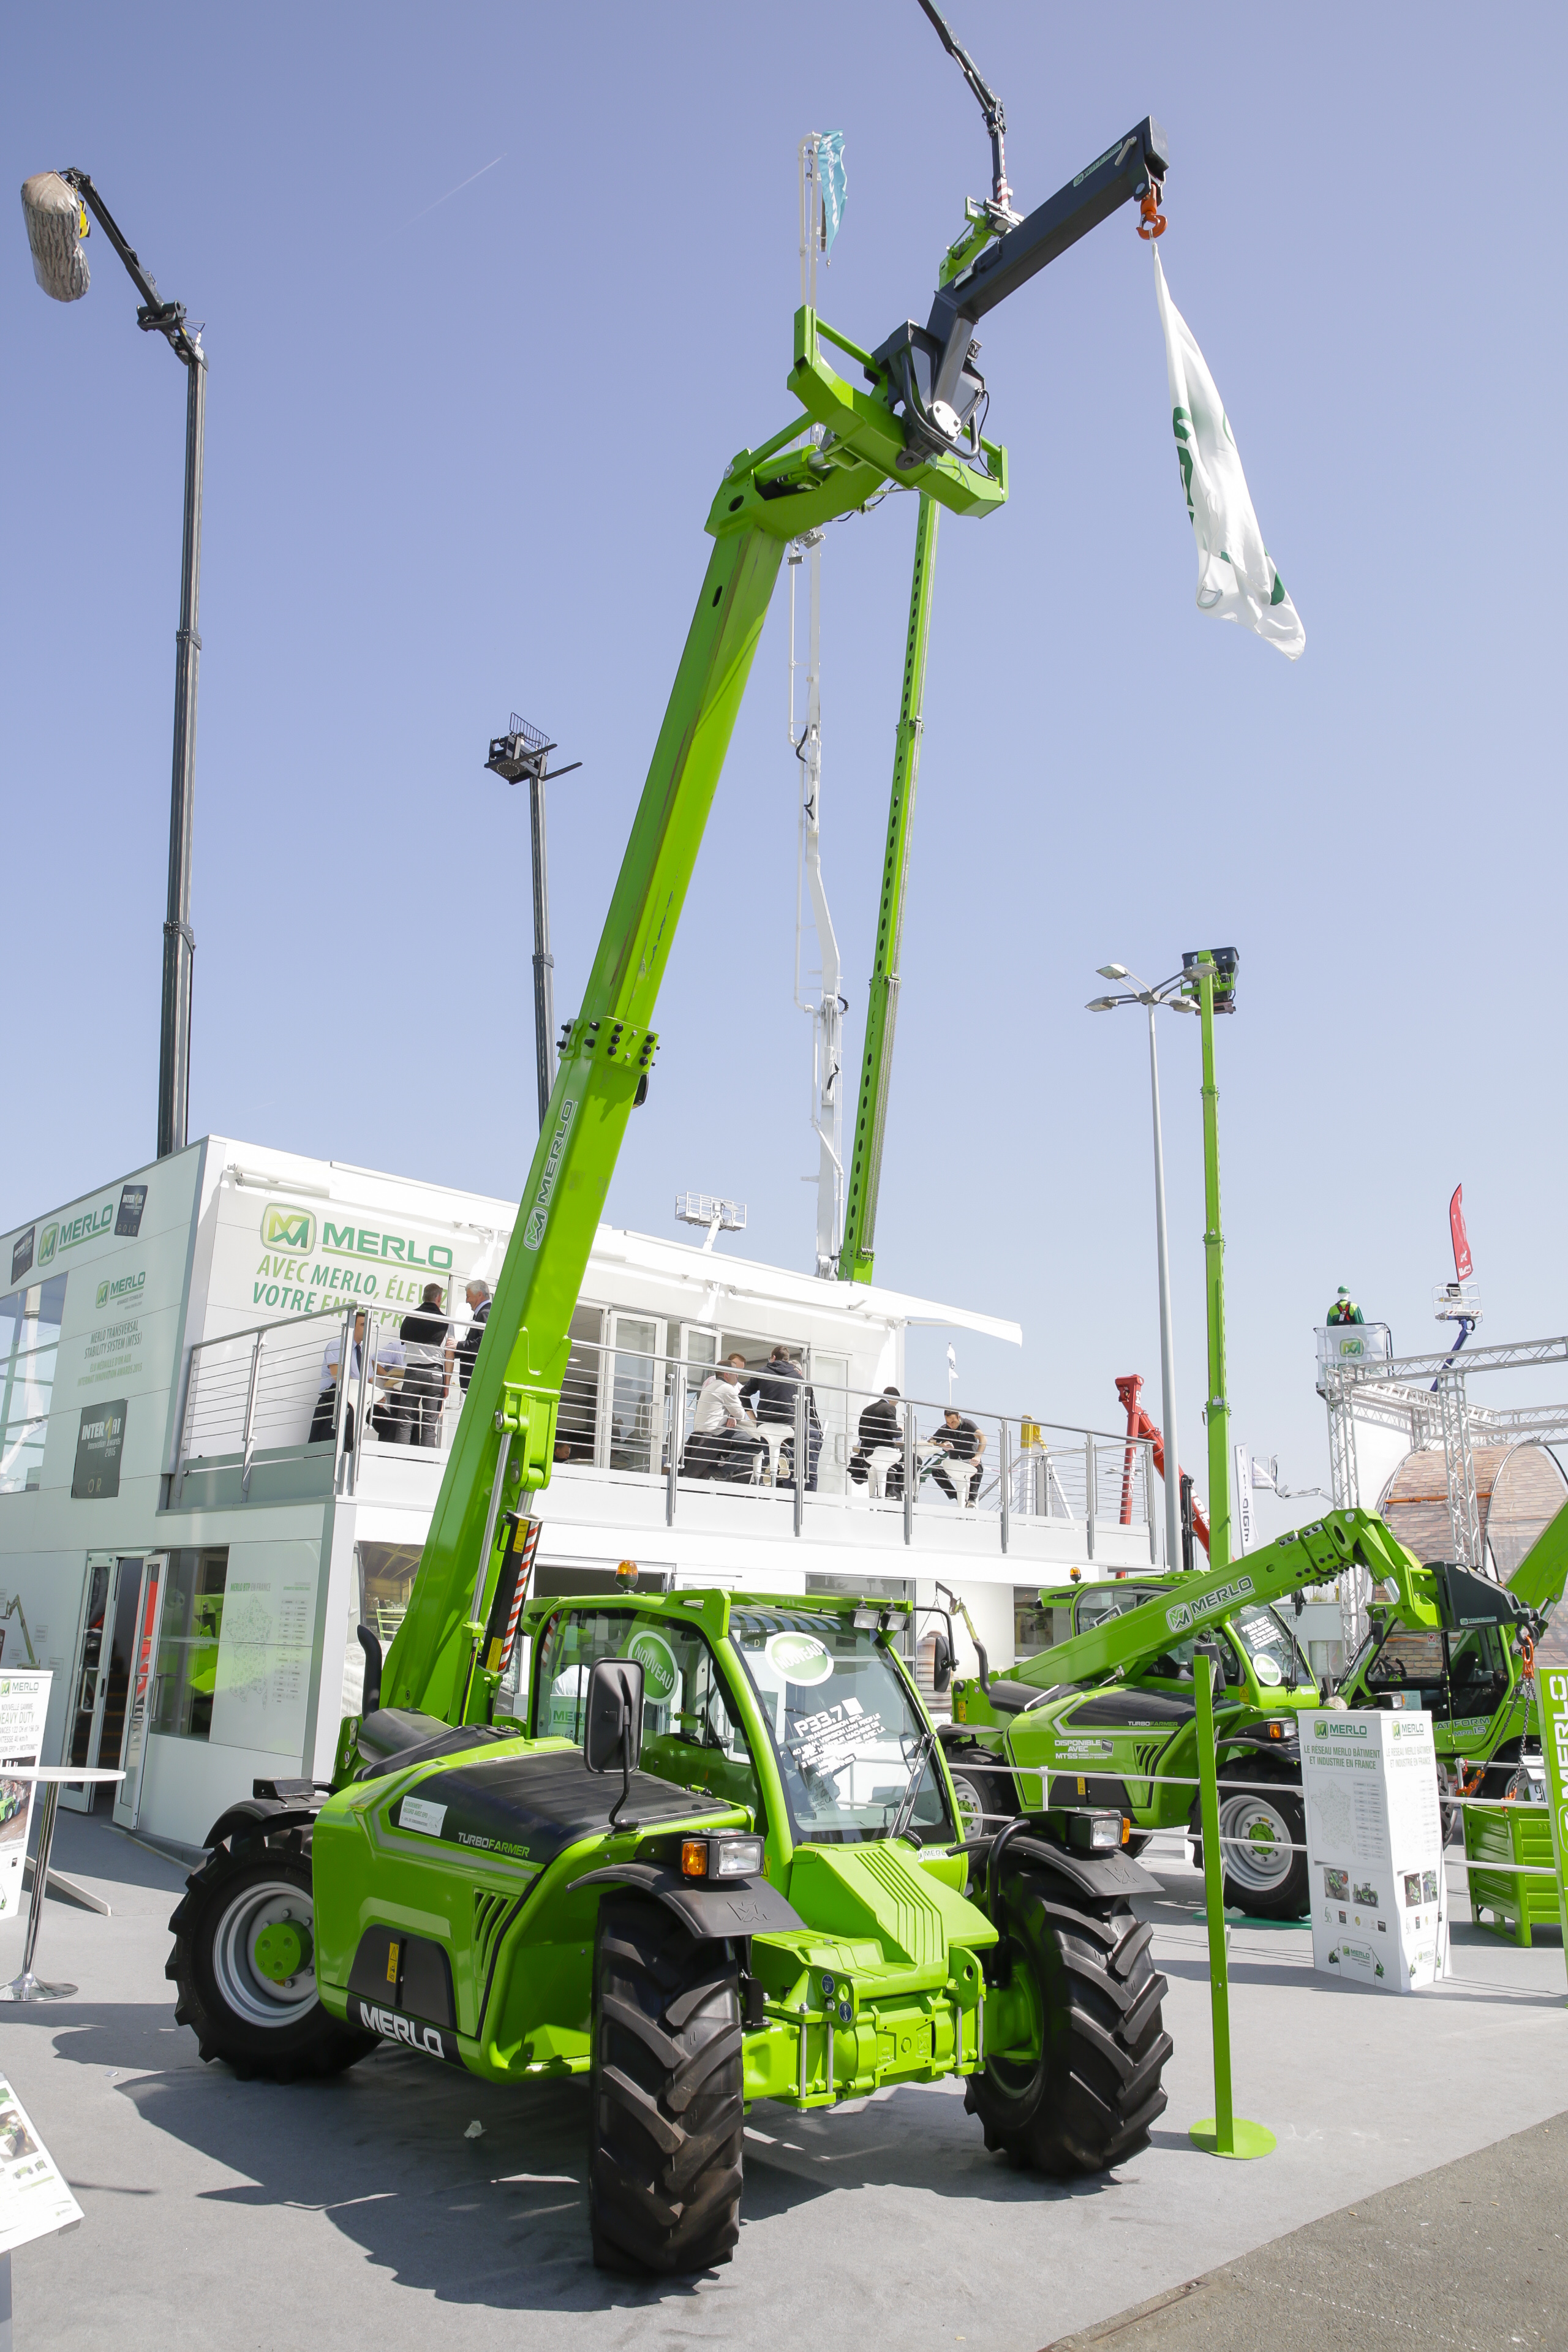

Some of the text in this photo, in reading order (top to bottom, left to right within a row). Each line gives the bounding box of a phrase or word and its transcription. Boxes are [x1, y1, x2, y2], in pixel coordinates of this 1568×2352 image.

[537, 1099, 574, 1205] MERLO
[59, 1204, 113, 1246] MERLO
[117, 1224, 136, 1233] GOLD
[323, 1222, 453, 1269] MERLO
[13, 1260, 30, 1281] GOLD
[110, 1272, 146, 1295] MERLO
[256, 1254, 448, 1309] AVEC MERLO, ÉLEVZ
[253, 1282, 317, 1313] VOTRE
[91, 1320, 138, 1344] MERLO TRANSVERSAL
[85, 1331, 142, 1359] STABILITY SYSTEM (MTSS)
[94, 1369, 116, 1383] INNOVATION
[116, 1365, 132, 1377] AWARDS
[133, 1362, 142, 1373] 2015
[88, 1438, 121, 1450] Innovation Awards
[105, 1447, 116, 1457] 2015
[88, 1478, 102, 1493] OR
[230, 1583, 243, 1591] MERLO
[1190, 1575, 1253, 1614] MERLO
[635, 1643, 673, 1690] NOUVEAU
[775, 1643, 824, 1670] NOUVEAU
[12, 1682, 39, 1691] MERLO
[0, 1711, 35, 1724] EAVY DUTY
[794, 1705, 842, 1737] P33.7
[1401, 1723, 1424, 1733] MERLO
[819, 1727, 846, 1744] VERSION
[845, 1723, 859, 1732] LOW
[1330, 1724, 1367, 1735] MERLO
[1304, 1744, 1380, 1758] LE RÉSEAU MERLO BÂTIMENT
[1405, 1746, 1417, 1755] MERLO
[1317, 1757, 1344, 1767] INDUSTRIE
[1346, 1758, 1353, 1768] EN
[1355, 1760, 1376, 1770] FRANCE
[404, 1801, 423, 1810] RENDEMENT
[458, 1832, 530, 1858] TURBOFARMER
[1351, 1948, 1370, 1959] MERLO
[1422, 1949, 1434, 1959] MERLO
[360, 2002, 445, 2058] MERLO
